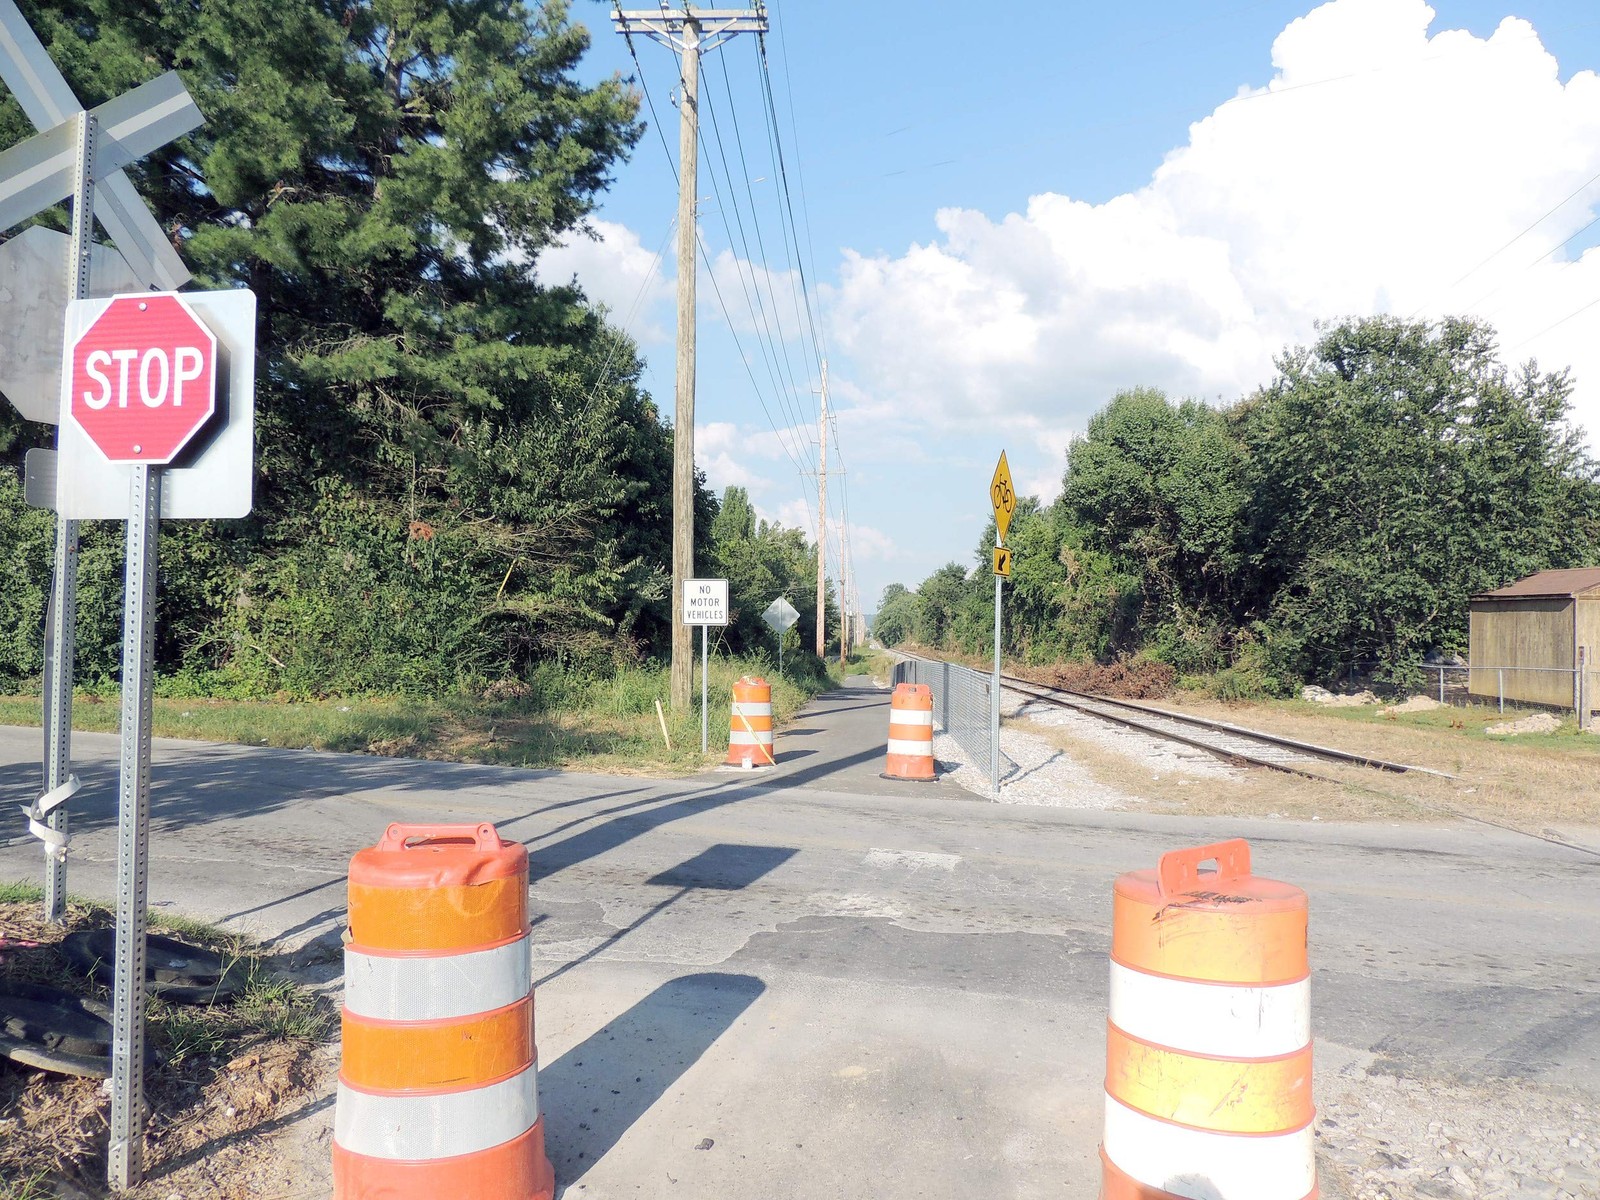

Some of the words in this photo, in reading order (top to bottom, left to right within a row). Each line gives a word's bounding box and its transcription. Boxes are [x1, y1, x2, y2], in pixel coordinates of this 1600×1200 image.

[83, 346, 204, 410] STOP
[699, 585, 711, 594] NO
[690, 598, 720, 607] MOTOR
[687, 610, 723, 619] VEHICLES
